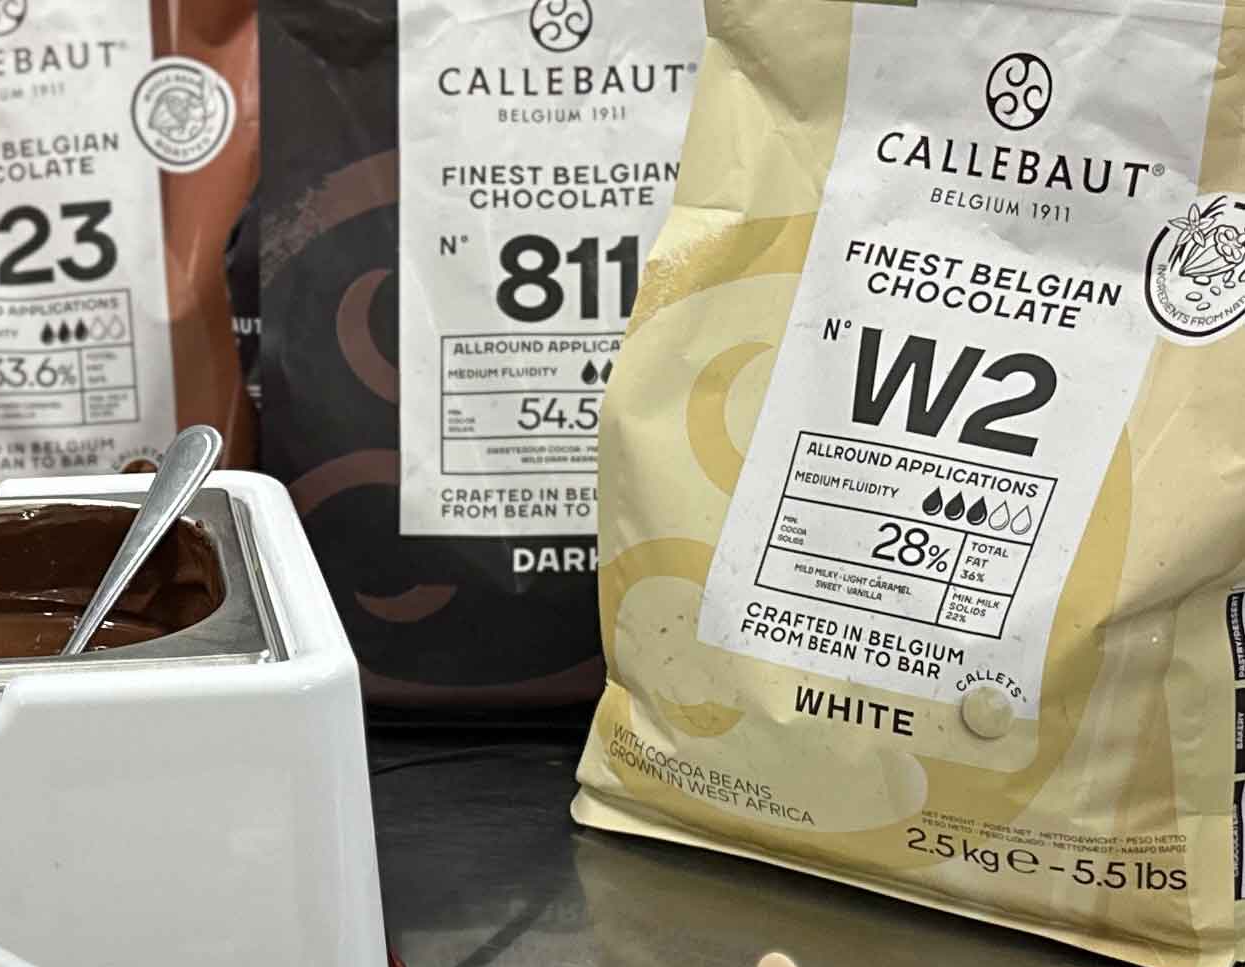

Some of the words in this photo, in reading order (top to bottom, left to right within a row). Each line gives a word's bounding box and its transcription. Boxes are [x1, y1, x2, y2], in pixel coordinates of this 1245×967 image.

[33, 82, 66, 98] 1911
[438, 64, 685, 96] CALLEBAUT
[498, 108, 582, 123] BELGIUM
[592, 105, 627, 121] 1911
[3, 133, 120, 161] BELGIAN
[442, 164, 543, 187] FINEST
[553, 161, 680, 186] BELGIAN
[469, 186, 655, 209] CHOCOLATE
[930, 187, 1019, 217] BELGIUM
[1031, 202, 1072, 222] 1911
[496, 234, 640, 323] 811
[846, 240, 962, 279] FINEST
[970, 262, 1122, 306] BELGIAN
[8, 297, 119, 317] APPLICATIONS
[867, 272, 1081, 329] CHOCOLATE
[453, 340, 544, 355] ALLROUND
[548, 339, 622, 353] APPLICA
[448, 367, 498, 379] MEDIUM
[502, 367, 558, 378] FLUIDITY
[852, 326, 1058, 457] W2
[8, 443, 26, 456] IN
[31, 438, 115, 456] BELGIUM
[32, 455, 55, 469] TO
[60, 453, 99, 467] BAR
[807, 441, 892, 468] ALLROUND
[895, 457, 1039, 498] APPLICATIONS
[441, 488, 533, 503] CRAFTED
[540, 488, 559, 502] IN
[795, 470, 840, 488] MEDIUM
[842, 479, 900, 498] FLUIDITY
[441, 504, 498, 519] FROM
[504, 503, 557, 518] BEAN
[564, 503, 591, 517] TO
[871, 522, 950, 573] 28%
[971, 541, 1010, 558] TOTAL
[965, 556, 989, 569] FAT
[794, 562, 814, 575] MILD
[815, 567, 839, 583] MILKY
[842, 572, 868, 586] LIGHT
[869, 578, 912, 596] CARAMEL
[814, 579, 842, 593] SWEET
[959, 569, 985, 583] 36%
[948, 601, 987, 618] SOLIDS
[976, 596, 1001, 610] MILK
[945, 611, 967, 624] 22%
[746, 601, 838, 637] CRAFTED
[843, 624, 863, 642] IN
[868, 630, 965, 666] BELGIUM
[740, 619, 804, 648] FROM
[807, 635, 858, 661] BEAN
[864, 647, 891, 669] TO
[897, 656, 941, 680] BAR
[794, 685, 915, 737] WHITE
[613, 723, 643, 752] WITH
[645, 746, 704, 780] COCOA
[709, 770, 772, 800] BEANS
[609, 740, 663, 780] GROWN
[666, 772, 683, 788] IN
[687, 778, 739, 805] WEST
[745, 797, 816, 825] AFRICA
[906, 826, 955, 858] 2.5
[961, 839, 999, 873] kg
[1071, 859, 1127, 889] 5.5
[1134, 862, 1187, 890] lbs
